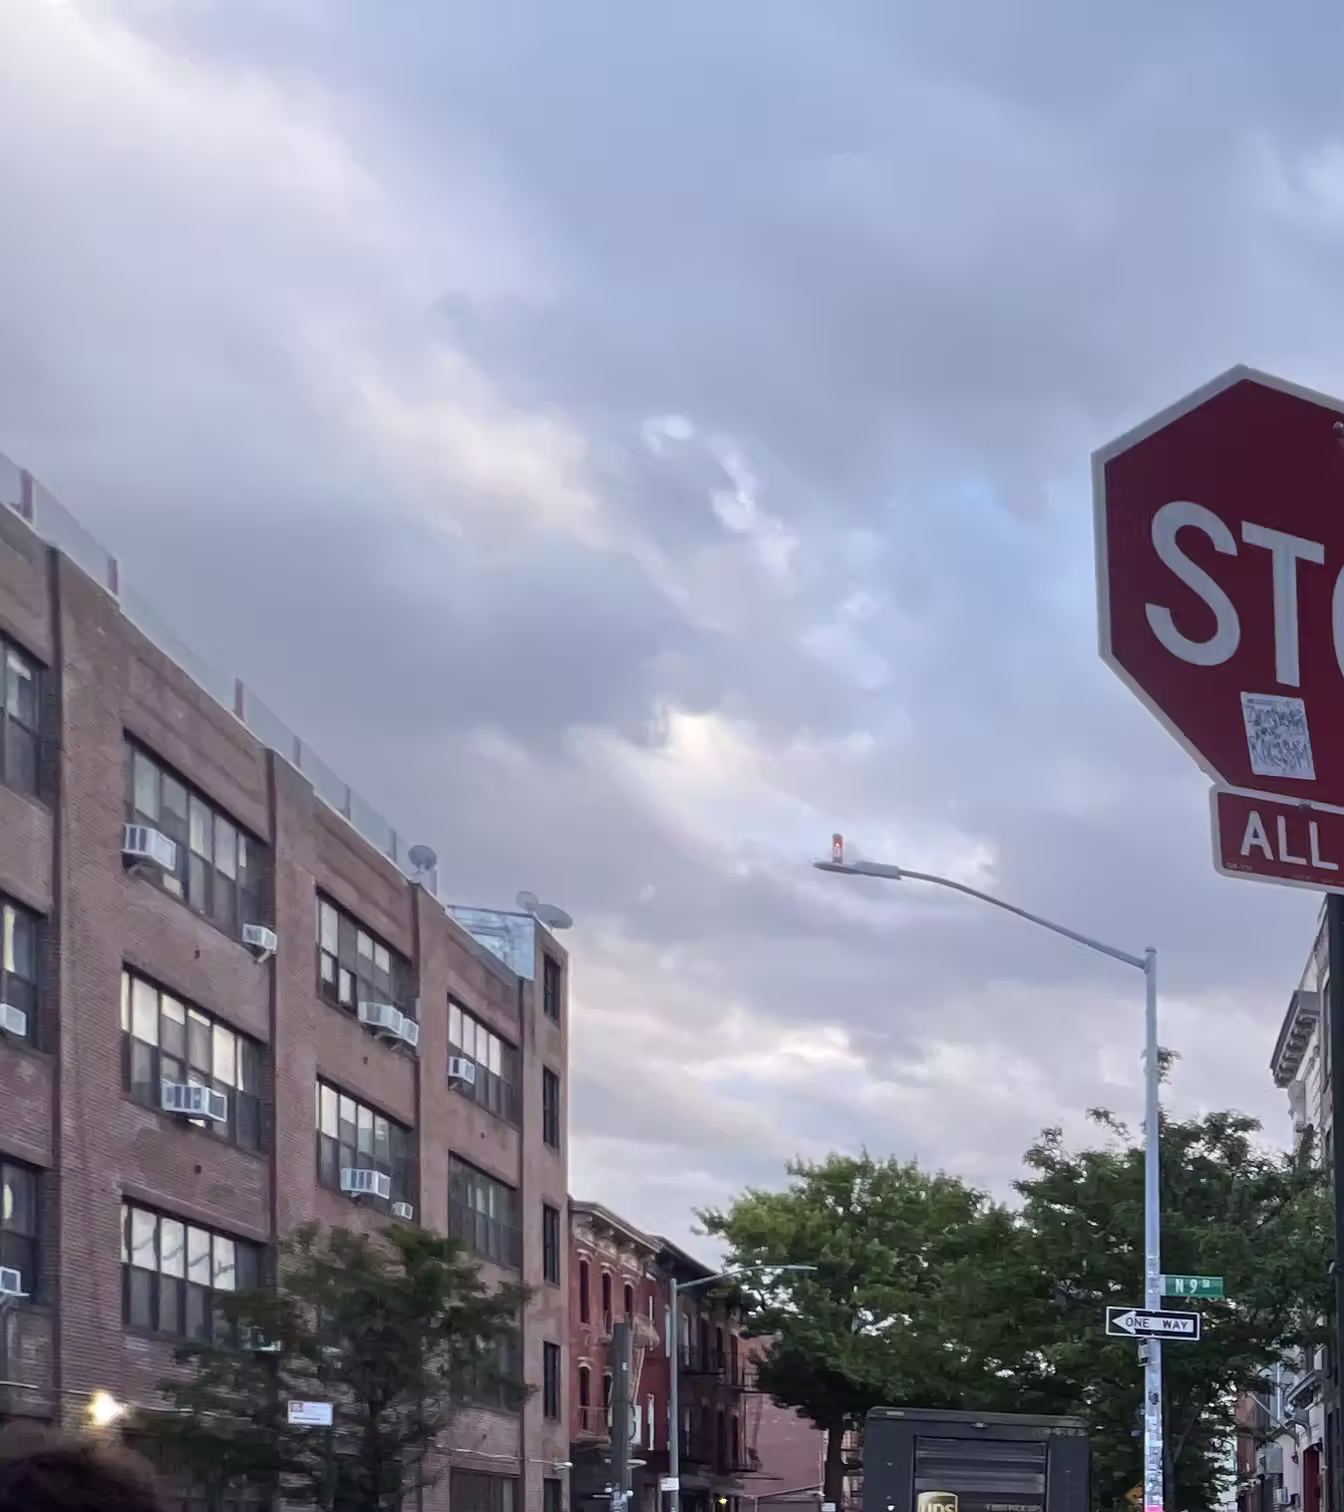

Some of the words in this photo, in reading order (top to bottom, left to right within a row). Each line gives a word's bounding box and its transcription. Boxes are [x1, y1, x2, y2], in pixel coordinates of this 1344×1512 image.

[1240, 810, 1339, 871] ALL
[1175, 1278, 1184, 1293] N
[1189, 1278, 1198, 1294] 9
[1125, 1317, 1150, 1328] ONE
[1162, 1320, 1189, 1330] WAY
